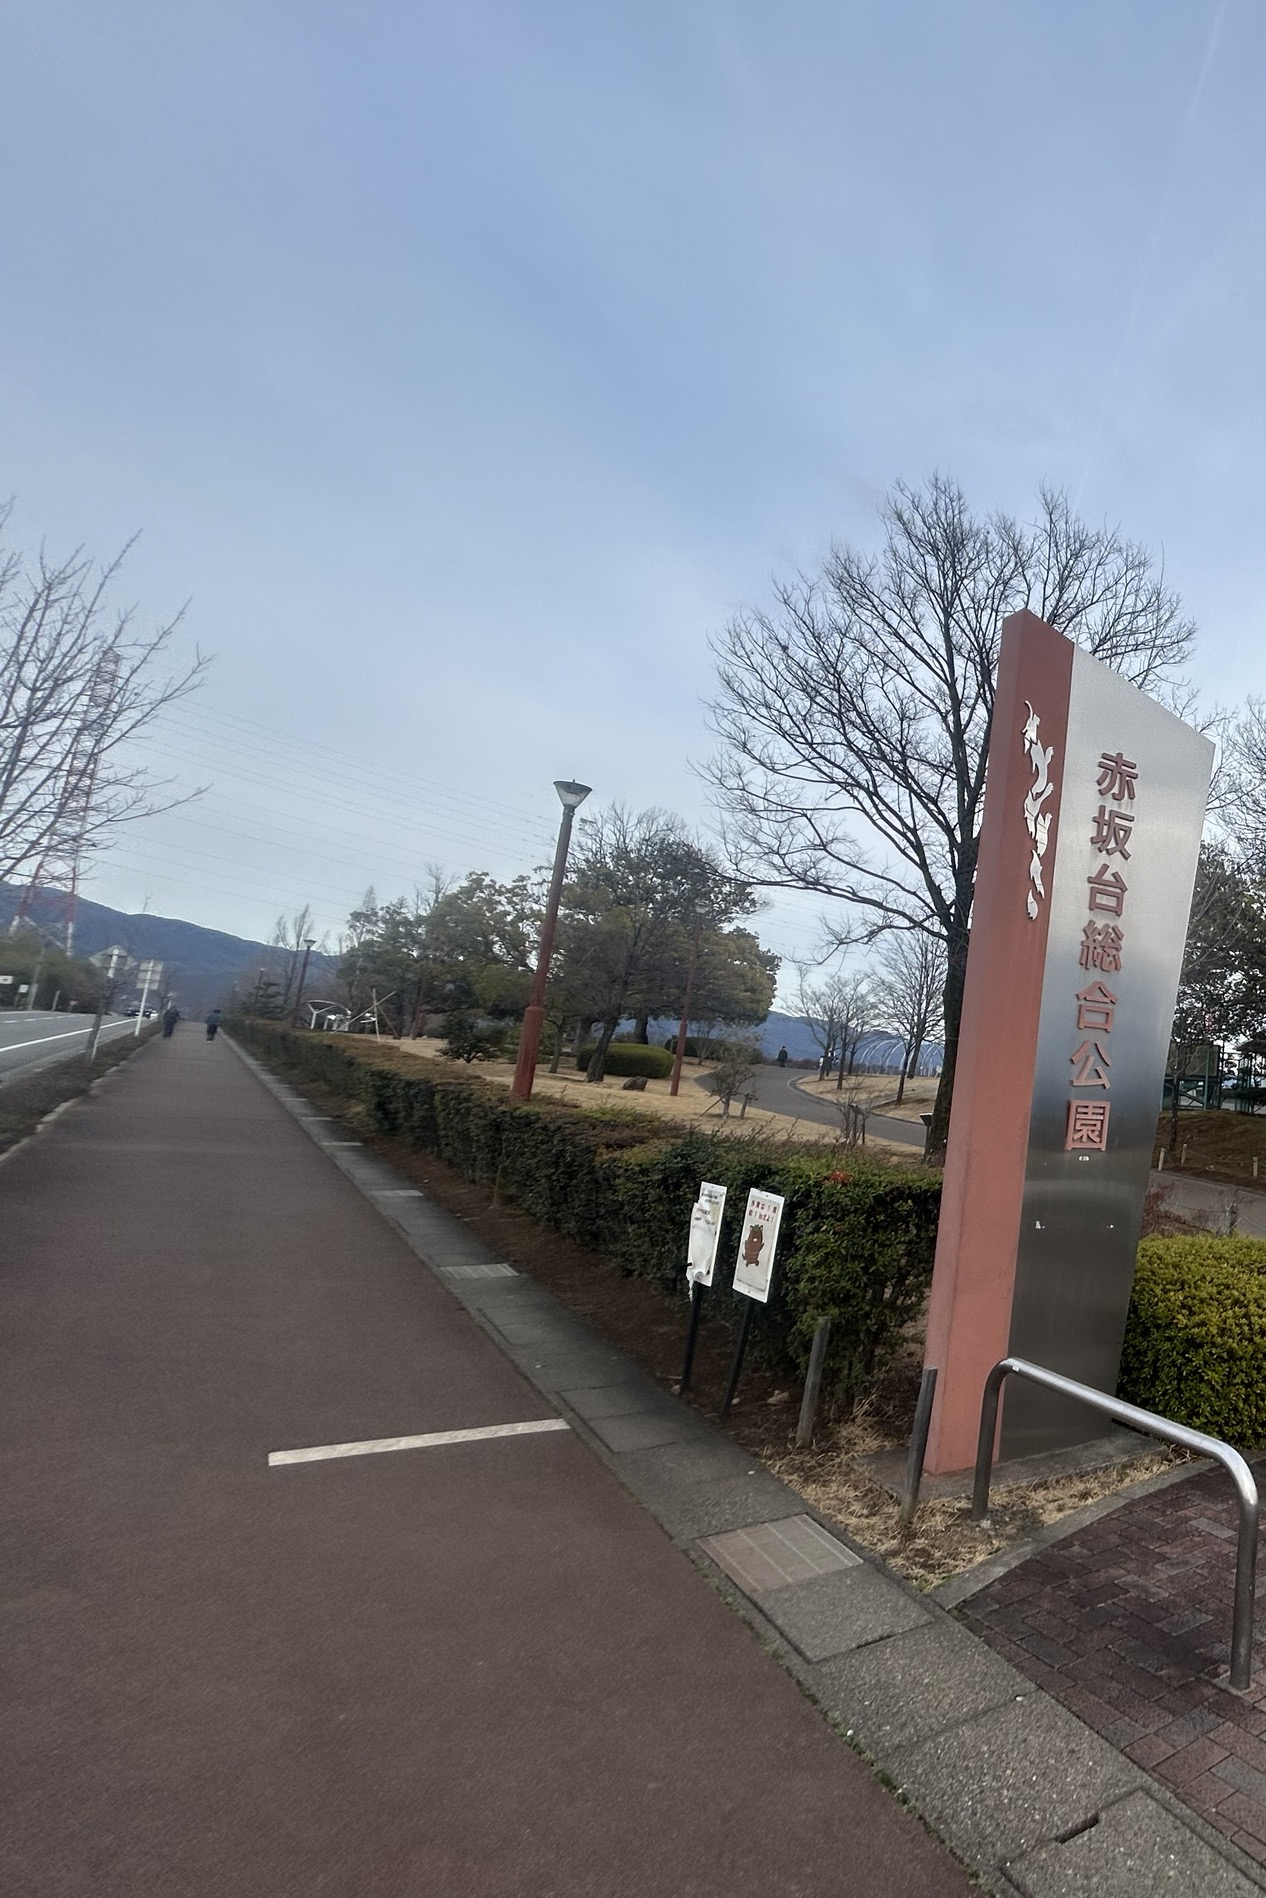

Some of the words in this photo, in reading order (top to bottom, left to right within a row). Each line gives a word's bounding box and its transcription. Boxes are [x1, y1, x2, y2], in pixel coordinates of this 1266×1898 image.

[1064, 752, 1139, 1151] 赤坂台総合公園
